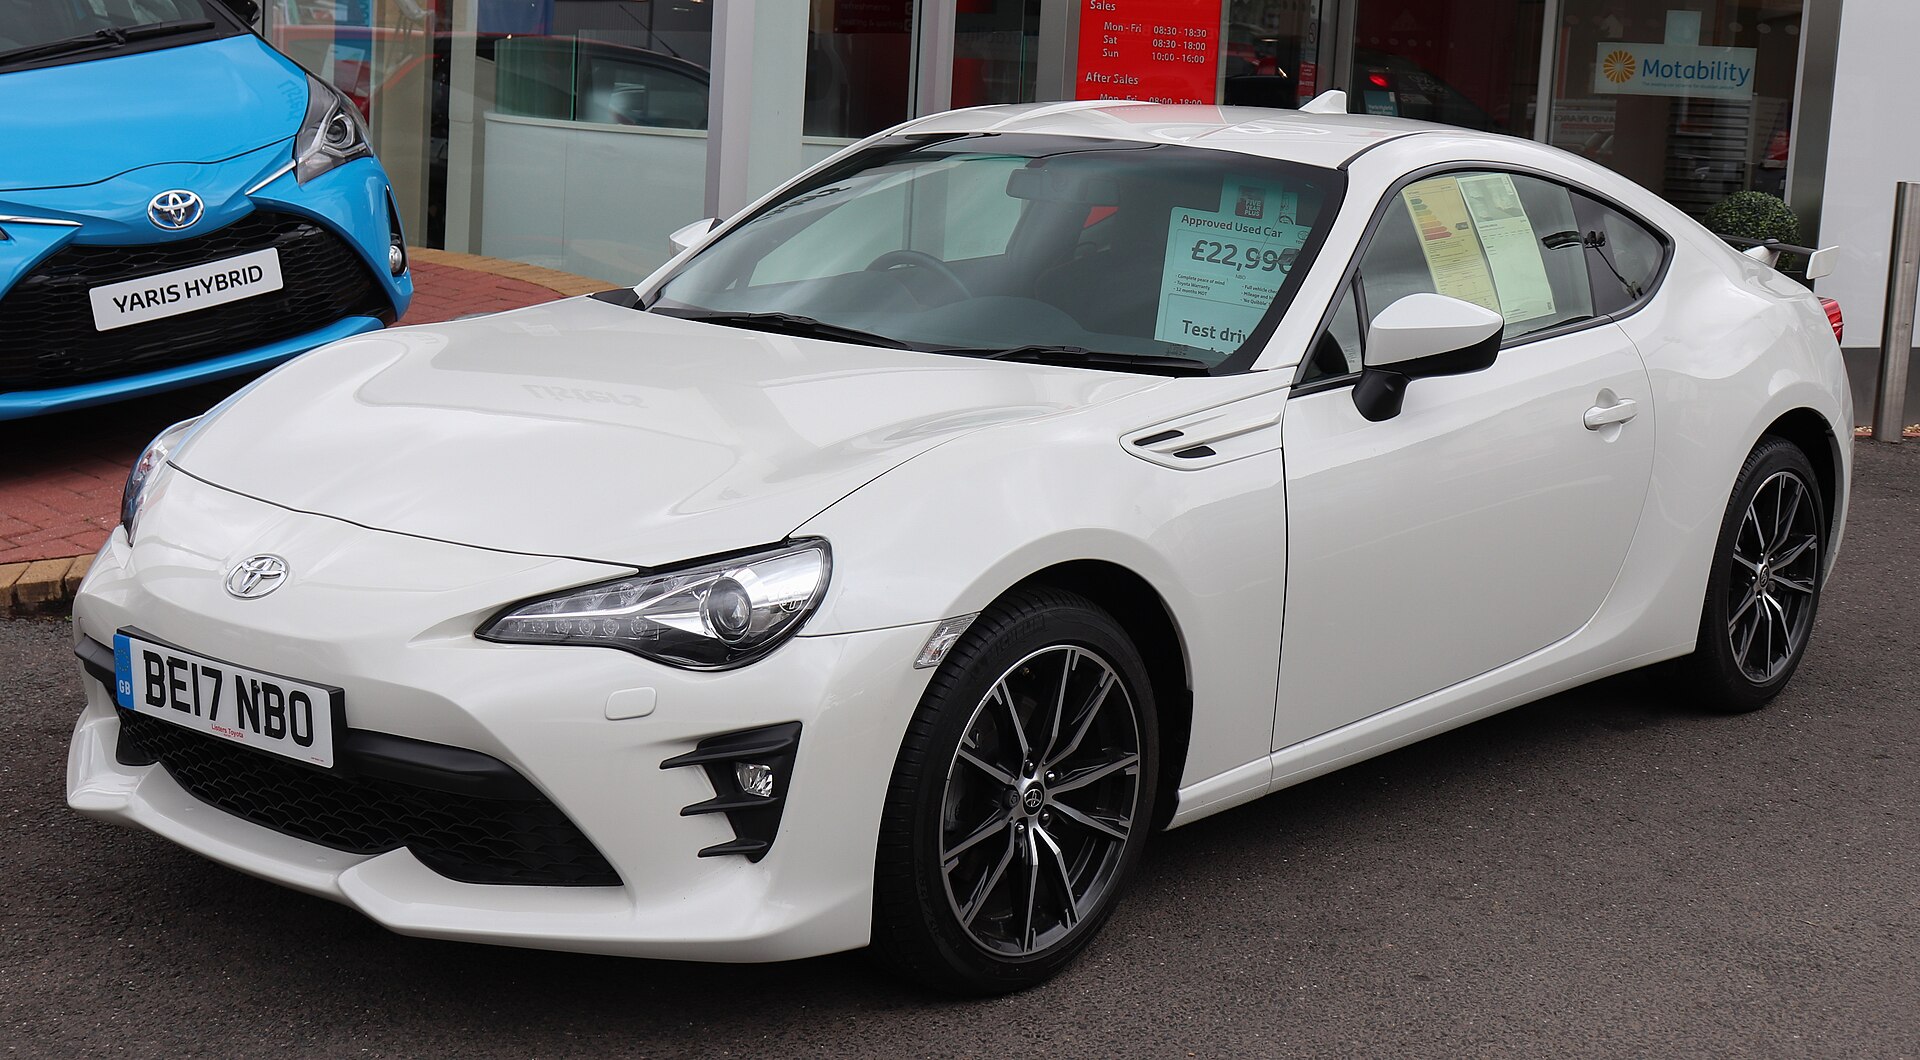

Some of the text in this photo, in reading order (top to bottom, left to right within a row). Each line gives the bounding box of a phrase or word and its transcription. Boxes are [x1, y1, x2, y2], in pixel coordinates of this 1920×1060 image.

[1090, 0, 1116, 11] Sales
[1104, 22, 1124, 32] Mon
[1130, 23, 1142, 33] Fri
[1153, 25, 1177, 36] 08:30
[1184, 28, 1207, 38] 18:30
[1103, 35, 1118, 45] Sat
[1152, 38, 1176, 49] 08:30
[1183, 41, 1206, 51] 18:00
[1102, 48, 1119, 58] Sun
[1151, 52, 1175, 62] 10:00
[1182, 54, 1205, 64] 16:00
[1085, 72, 1139, 85] After Sales
[1642, 59, 1751, 87] Motability
[1100, 93, 1119, 101] Mon
[1149, 96, 1173, 105] 08:00
[1245, 199, 1262, 207] FIVE
[1244, 209, 1260, 217] PLUS
[1181, 214, 1283, 238] Approved Used Car
[1177, 273, 1197, 282] Complete
[113, 265, 263, 313] YARIS HYBRID
[1177, 280, 1211, 291] Toyota Warranty
[1181, 287, 1198, 295] months
[1243, 291, 1262, 300] Mileage
[1182, 319, 1216, 339] Test
[118, 679, 131, 696] GB
[143, 649, 314, 748] BE17 NBO
[211, 723, 227, 734] Listers
[227, 728, 244, 739] Toyota
